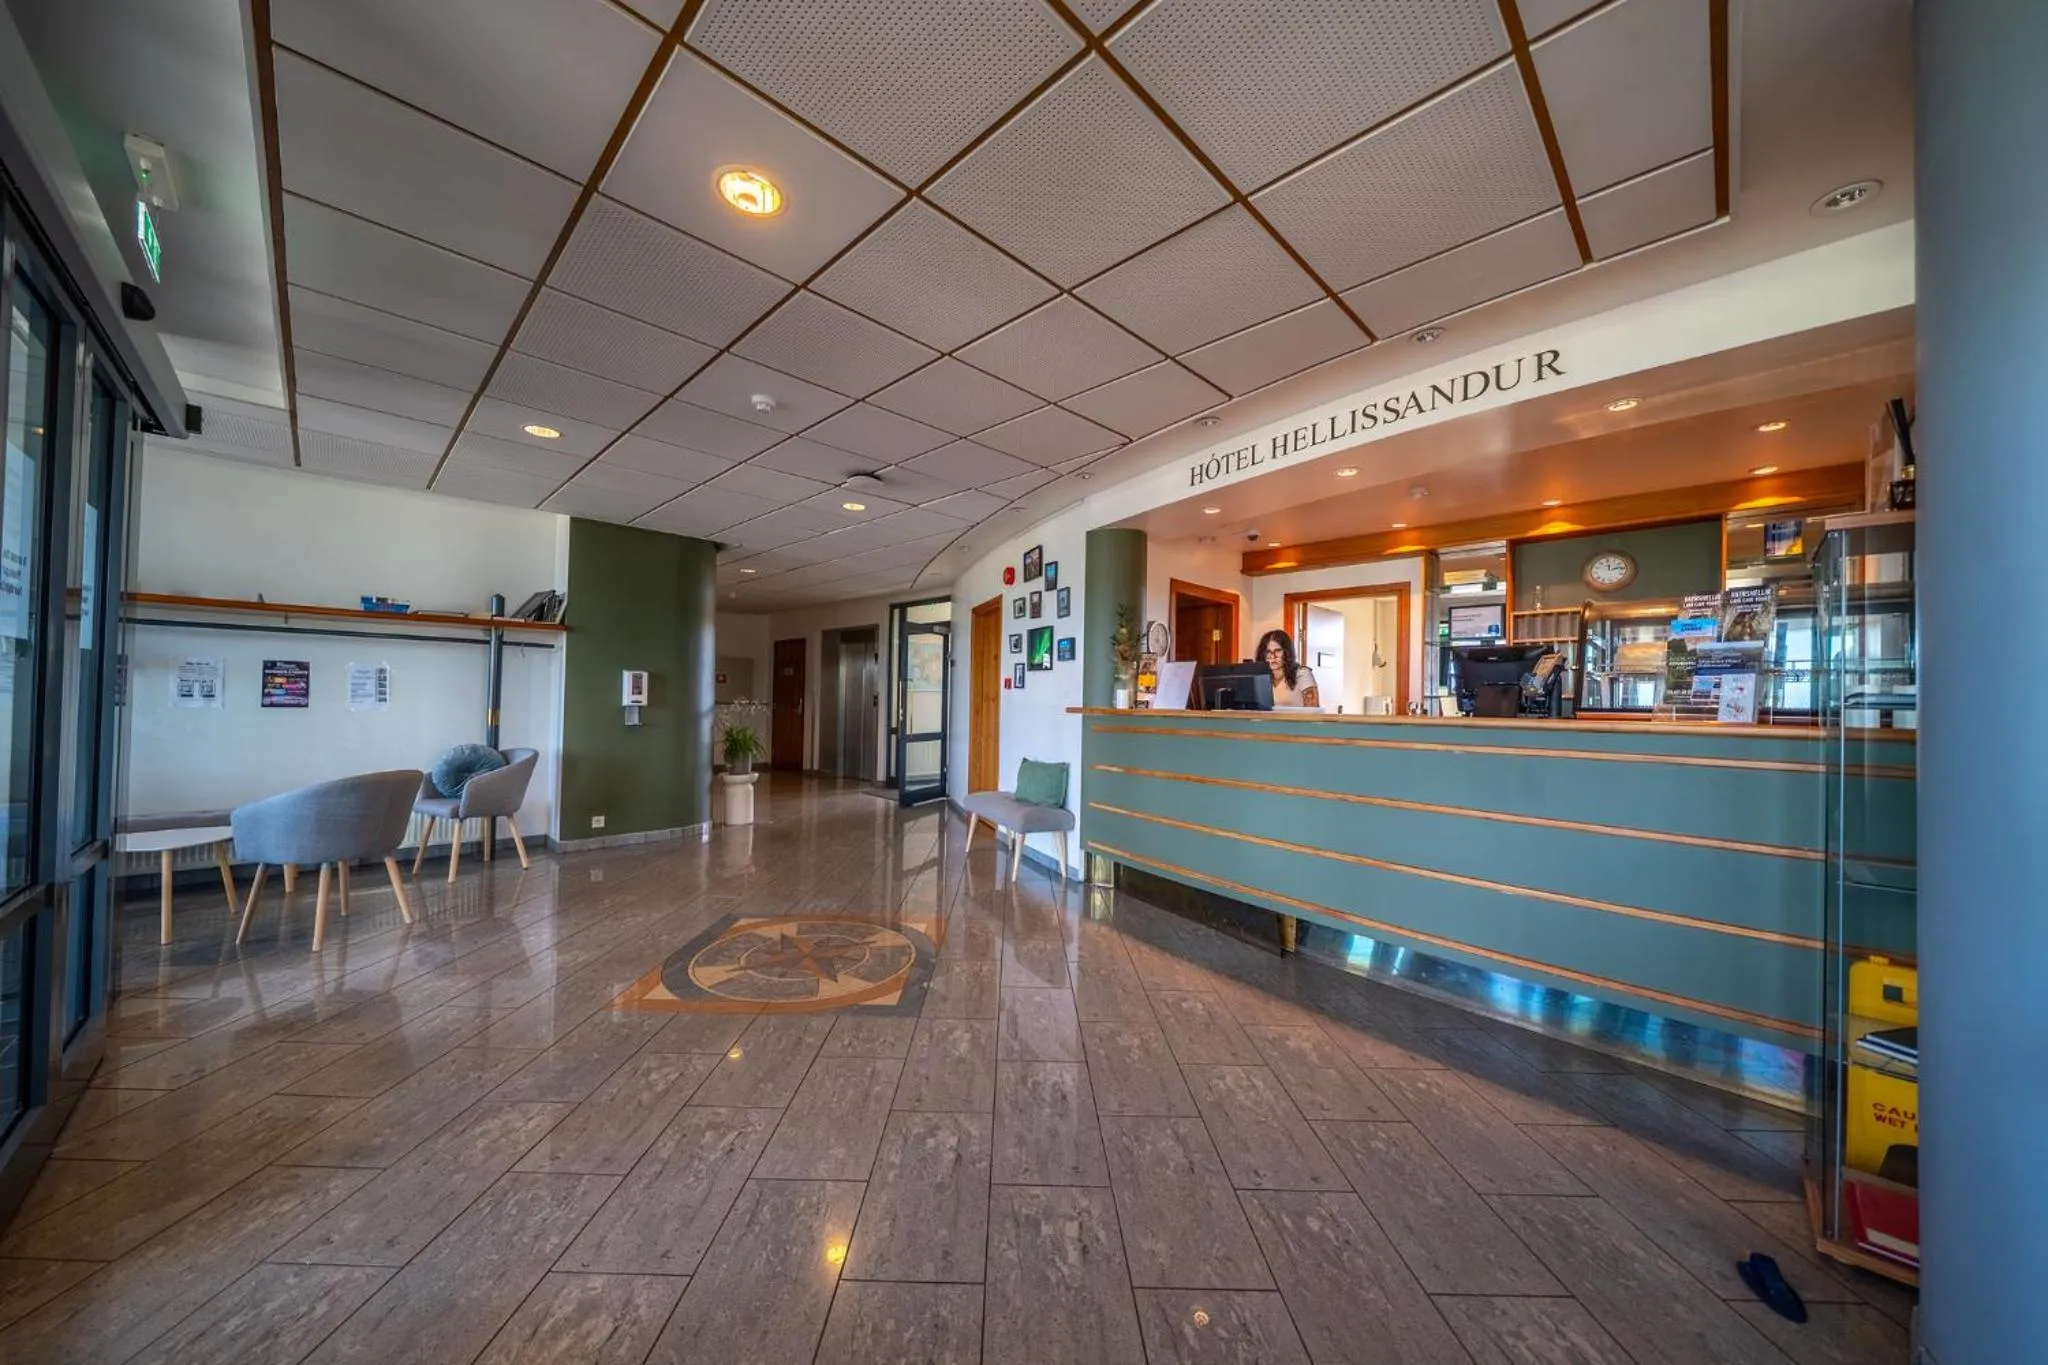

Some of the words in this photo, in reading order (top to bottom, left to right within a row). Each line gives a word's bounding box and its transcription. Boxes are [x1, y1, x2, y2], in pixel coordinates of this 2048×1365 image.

[1189, 445, 1265, 487] HÓTEL
[1270, 348, 1566, 460] HELLISSANDUR
[1874, 1112, 1906, 1129] WET
